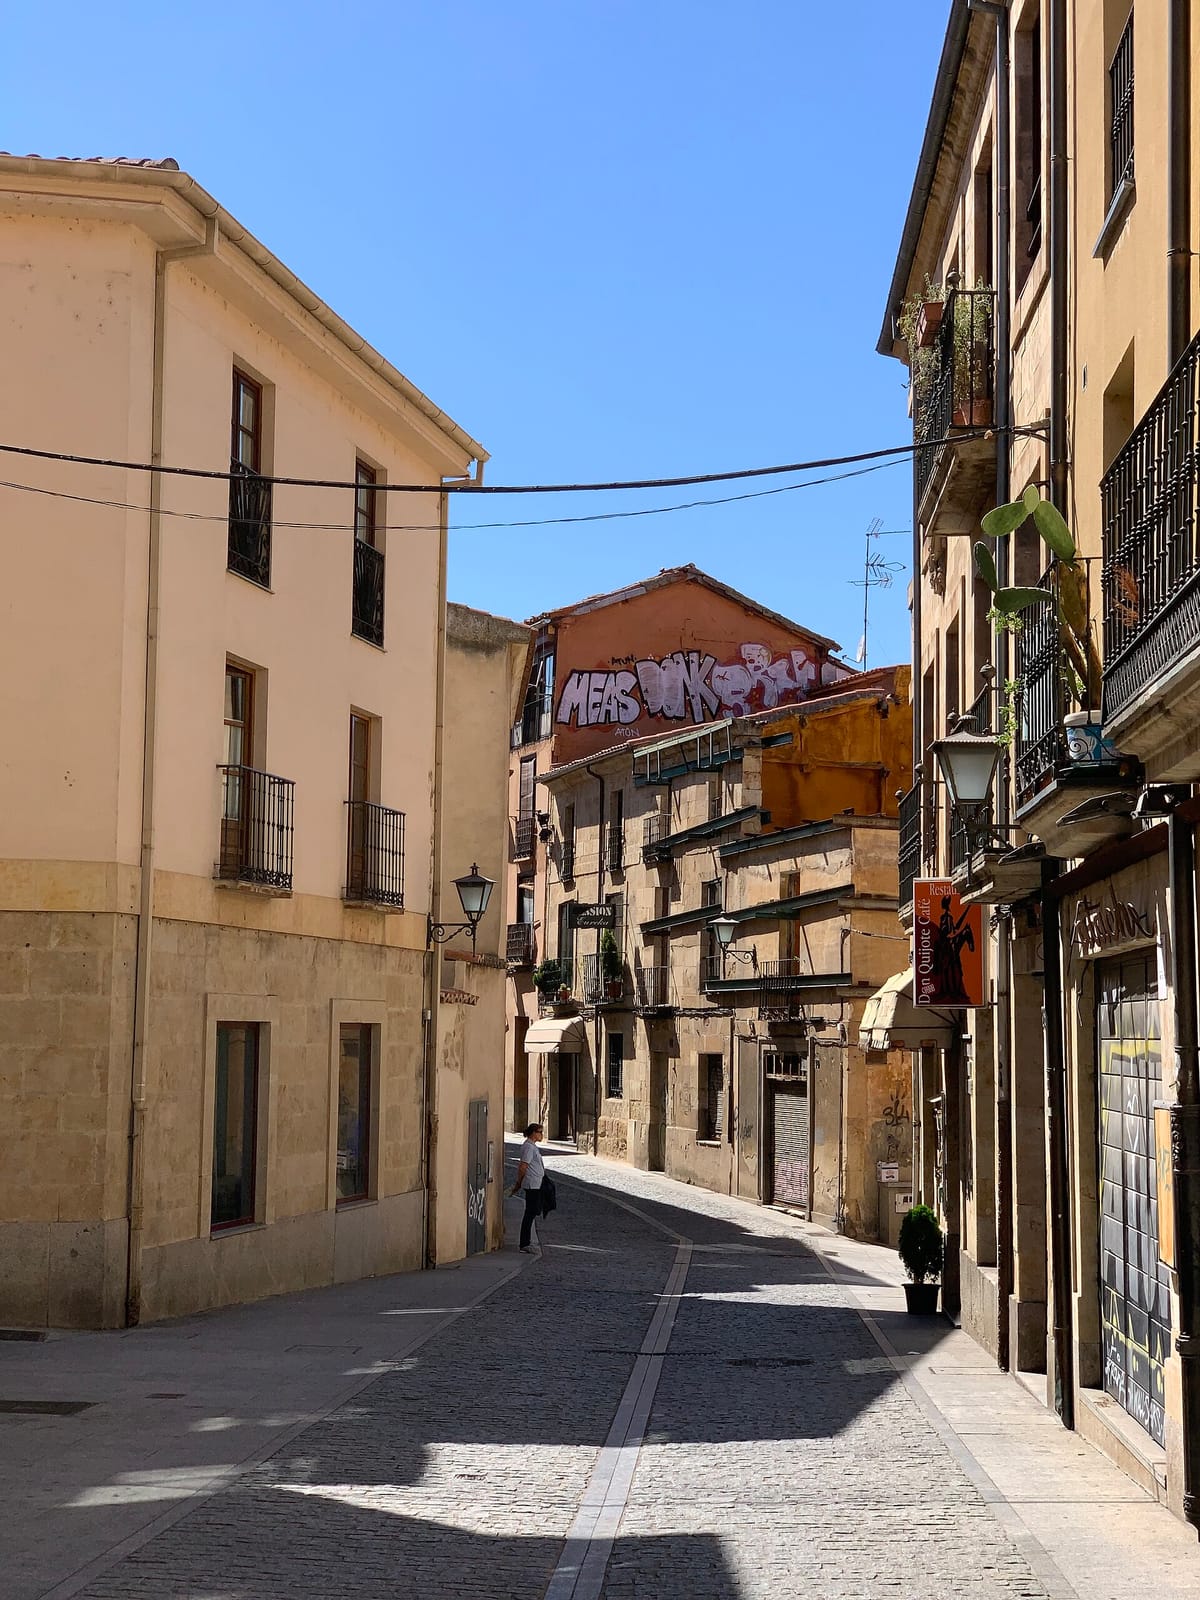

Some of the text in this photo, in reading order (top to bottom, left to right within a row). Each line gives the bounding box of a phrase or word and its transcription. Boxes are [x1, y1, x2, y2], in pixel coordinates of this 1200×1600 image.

[556, 669, 641, 727] MEAS
[614, 727, 640, 737] ATON
[929, 883, 960, 896] Restau
[917, 898, 931, 925] Café
[918, 928, 934, 974] Quijote
